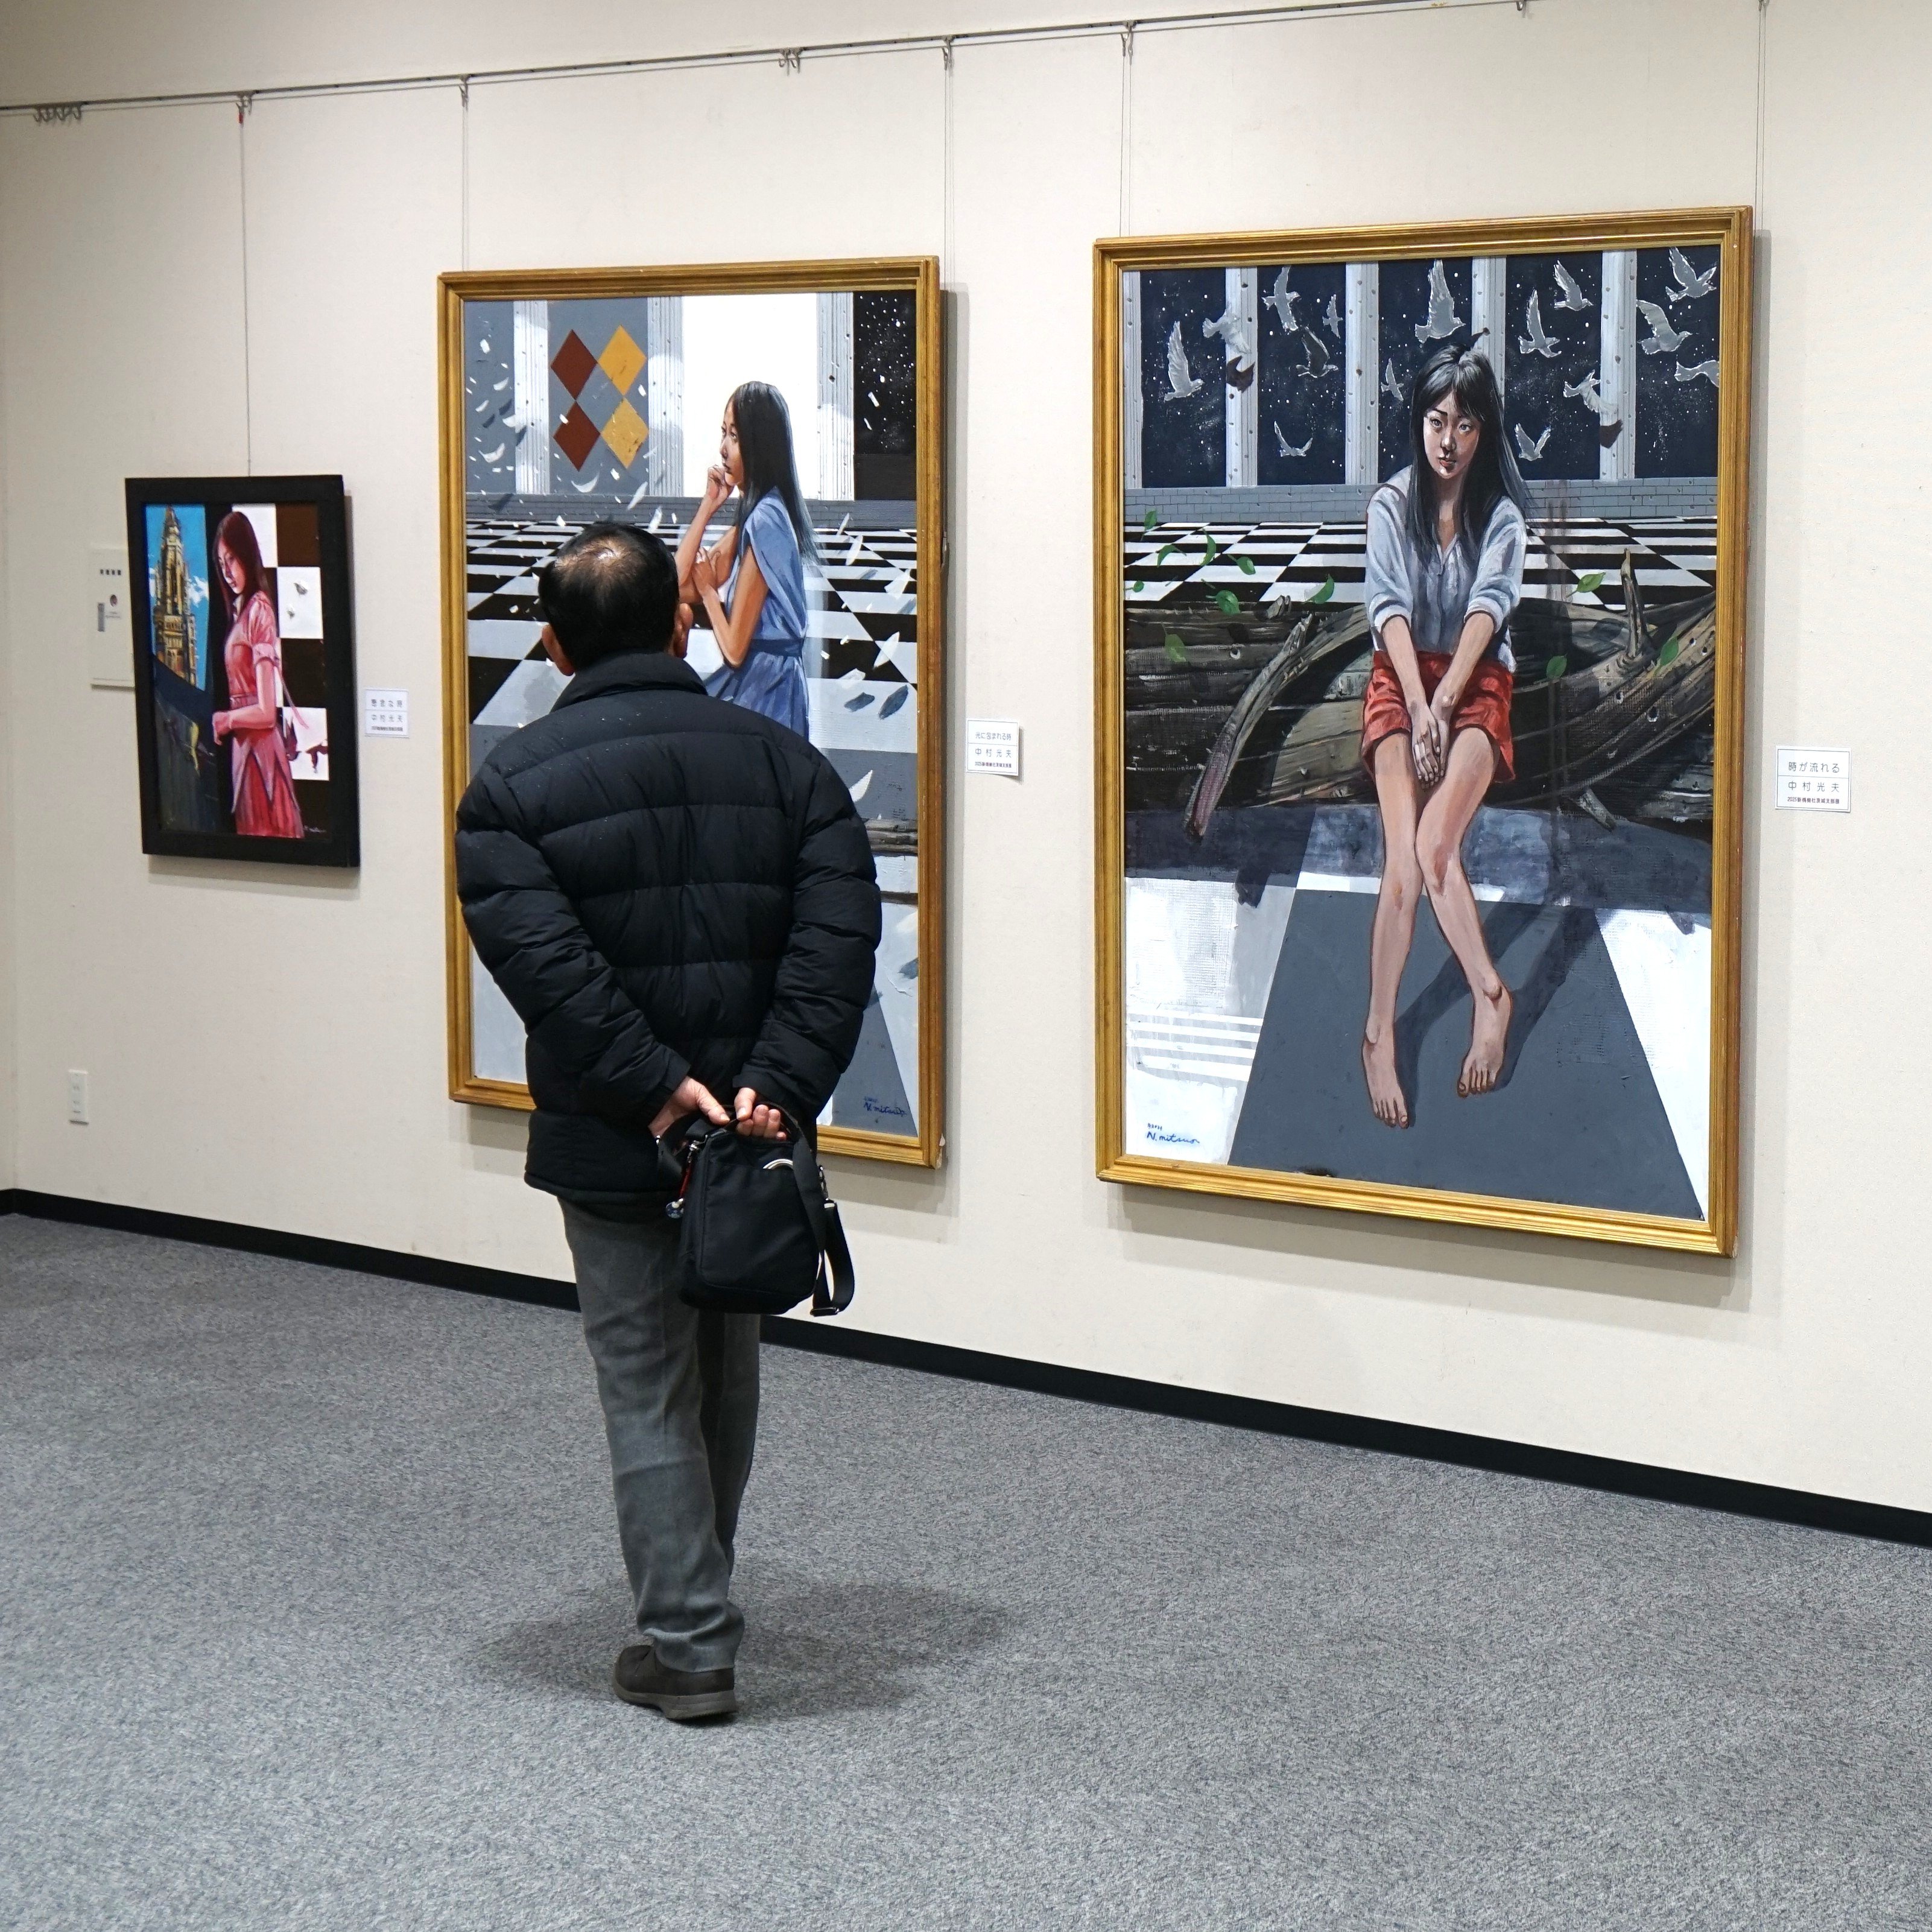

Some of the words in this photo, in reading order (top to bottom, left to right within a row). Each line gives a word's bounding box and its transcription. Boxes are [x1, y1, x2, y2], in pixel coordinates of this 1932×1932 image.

[975, 748, 1012, 758] 中村光夫
[1788, 761, 1840, 773] 時が流れる
[1788, 781, 1839, 793] 中村光夫
